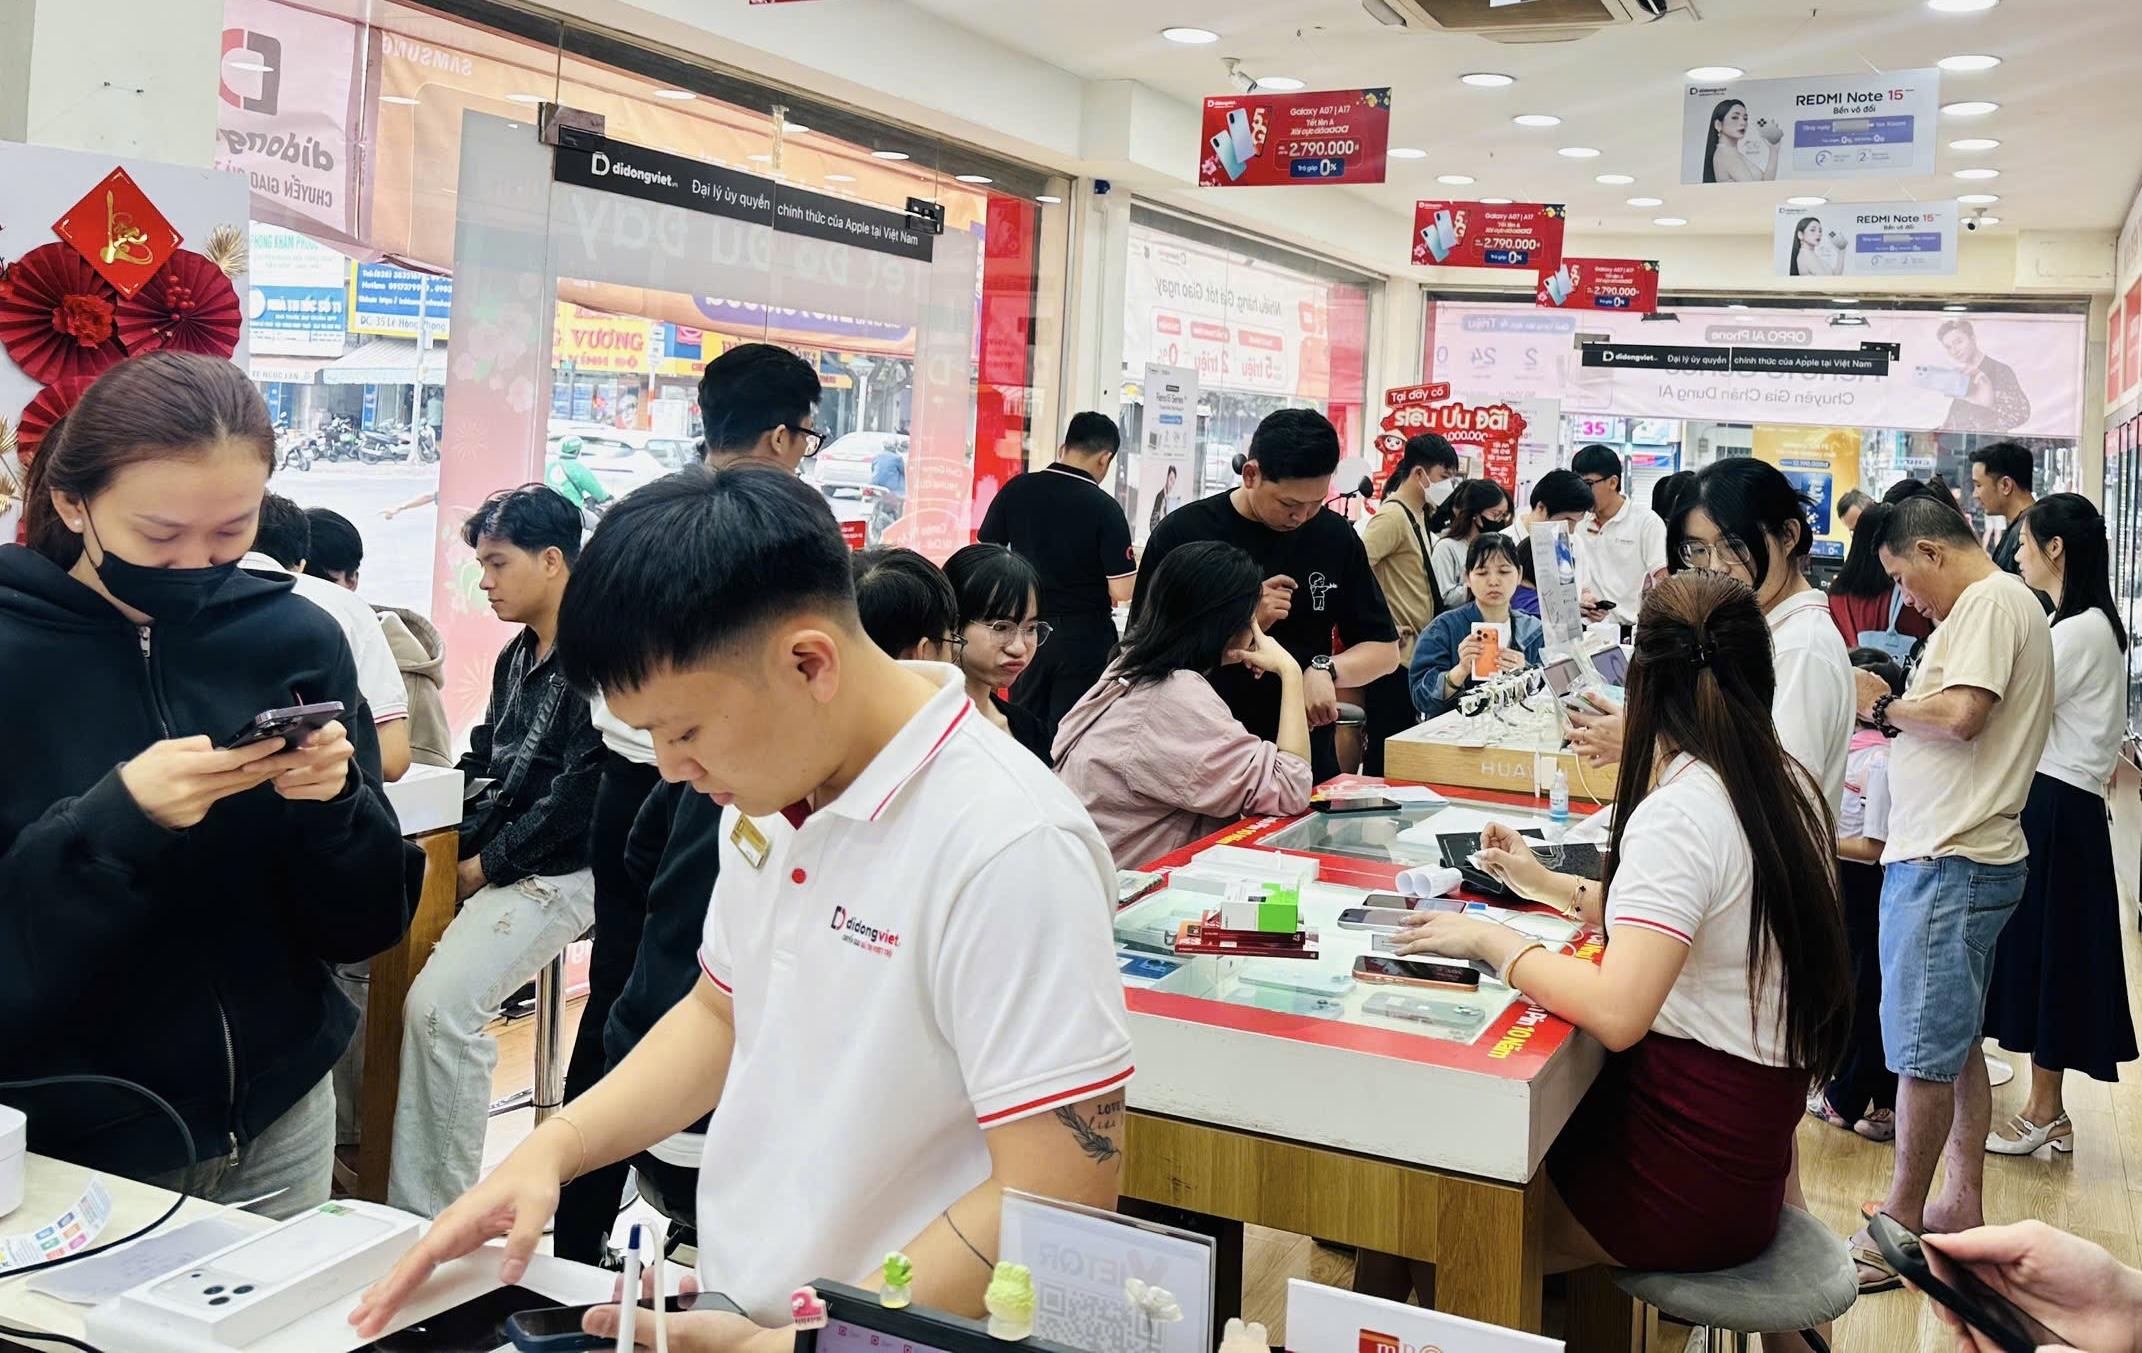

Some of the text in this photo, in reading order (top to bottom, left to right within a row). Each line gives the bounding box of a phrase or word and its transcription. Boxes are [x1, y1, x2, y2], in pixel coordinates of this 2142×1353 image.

[1796, 89, 1904, 107] REDMI Note 15
[1290, 105, 1351, 117] Galaxy A07 A17
[1320, 158, 1337, 176] 0%
[691, 178, 711, 200] Đại
[712, 183, 723, 202] lý
[827, 213, 844, 230] của
[845, 217, 870, 236] Apple
[871, 224, 882, 241] tại
[883, 225, 899, 244] Việt
[900, 231, 919, 246] Nam
[1856, 214, 1934, 224] REDMI Note 15
[570, 329, 644, 352] VƯƠNG
[1667, 354, 1681, 364] Đại
[1682, 354, 1689, 365] lý
[1778, 357, 1793, 367] của
[1795, 358, 1820, 369] Apple
[1821, 358, 1832, 369] tại
[1833, 358, 1851, 369] Việt
[1852, 360, 1873, 369] Nam
[1390, 386, 1444, 404] Tại đây có
[1475, 408, 1509, 432] Đãi
[1582, 421, 1605, 436] 35
[1507, 1025, 1535, 1039] 10
